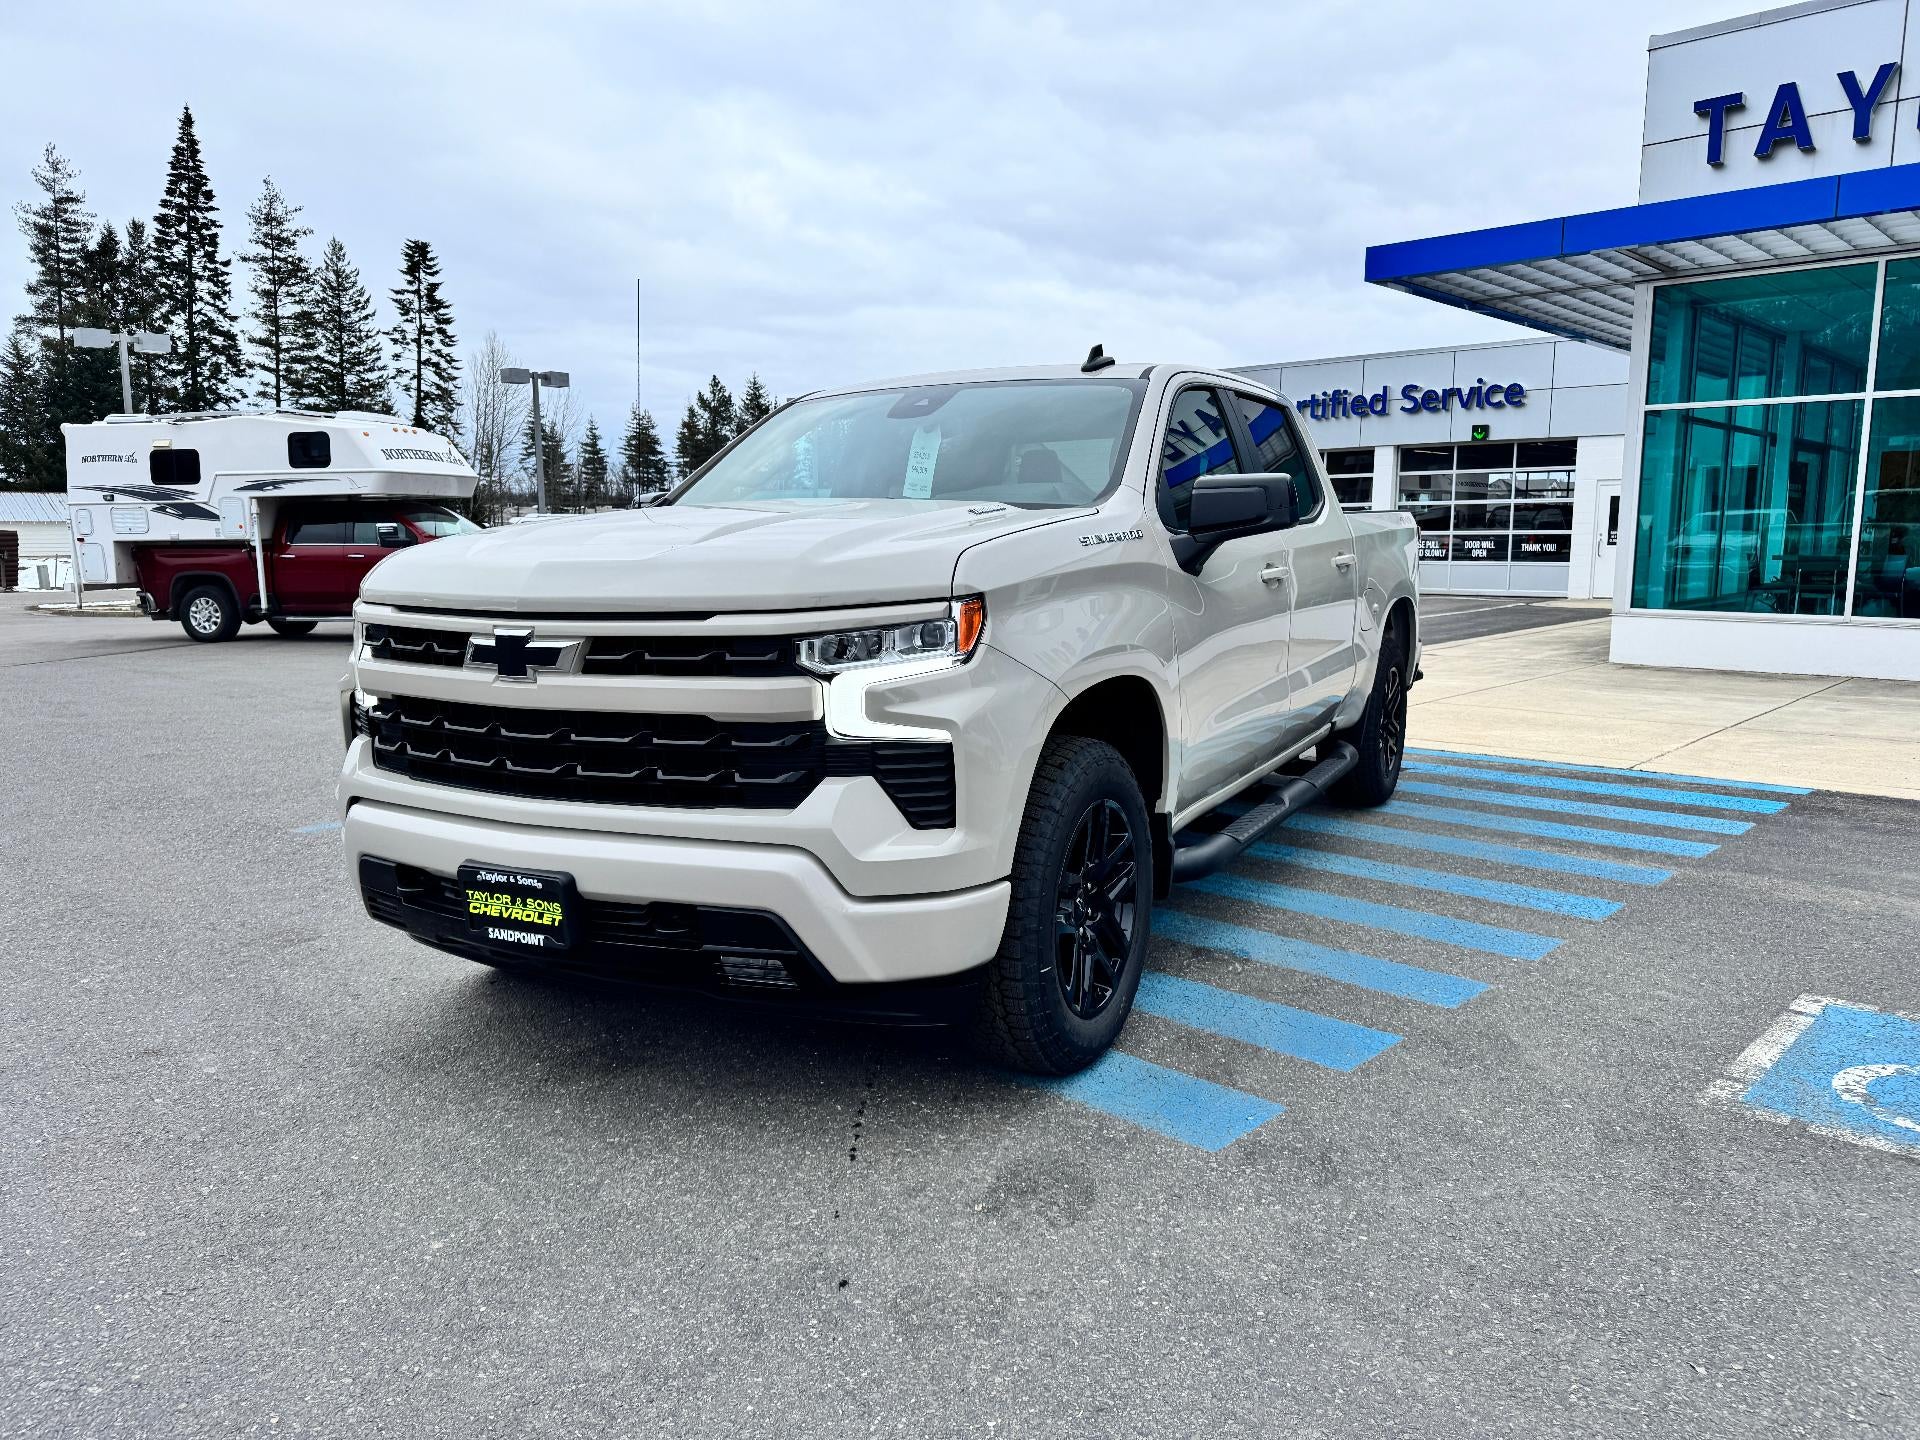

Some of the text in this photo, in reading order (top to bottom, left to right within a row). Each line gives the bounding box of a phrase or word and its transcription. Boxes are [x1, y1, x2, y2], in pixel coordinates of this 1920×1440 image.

[1693, 61, 1920, 167] TAY
[1400, 377, 1527, 414] Service
[81, 454, 124, 464] NORTHERN
[380, 448, 445, 463] NORTHERN
[1078, 529, 1144, 547] SILVERADO
[1426, 540, 1440, 549] PULL
[1464, 540, 1496, 549] DOOR WILL
[1425, 549, 1447, 558] SLOWLY
[1471, 549, 1487, 558] OPEN
[1521, 543, 1557, 552] THANK YOU!
[480, 871, 508, 883] Taylor
[517, 875, 538, 887] Sons
[466, 890, 562, 914] TAYLOR & SONS
[468, 902, 563, 927] CHEVROLET
[488, 927, 545, 947] SANDPOINT
